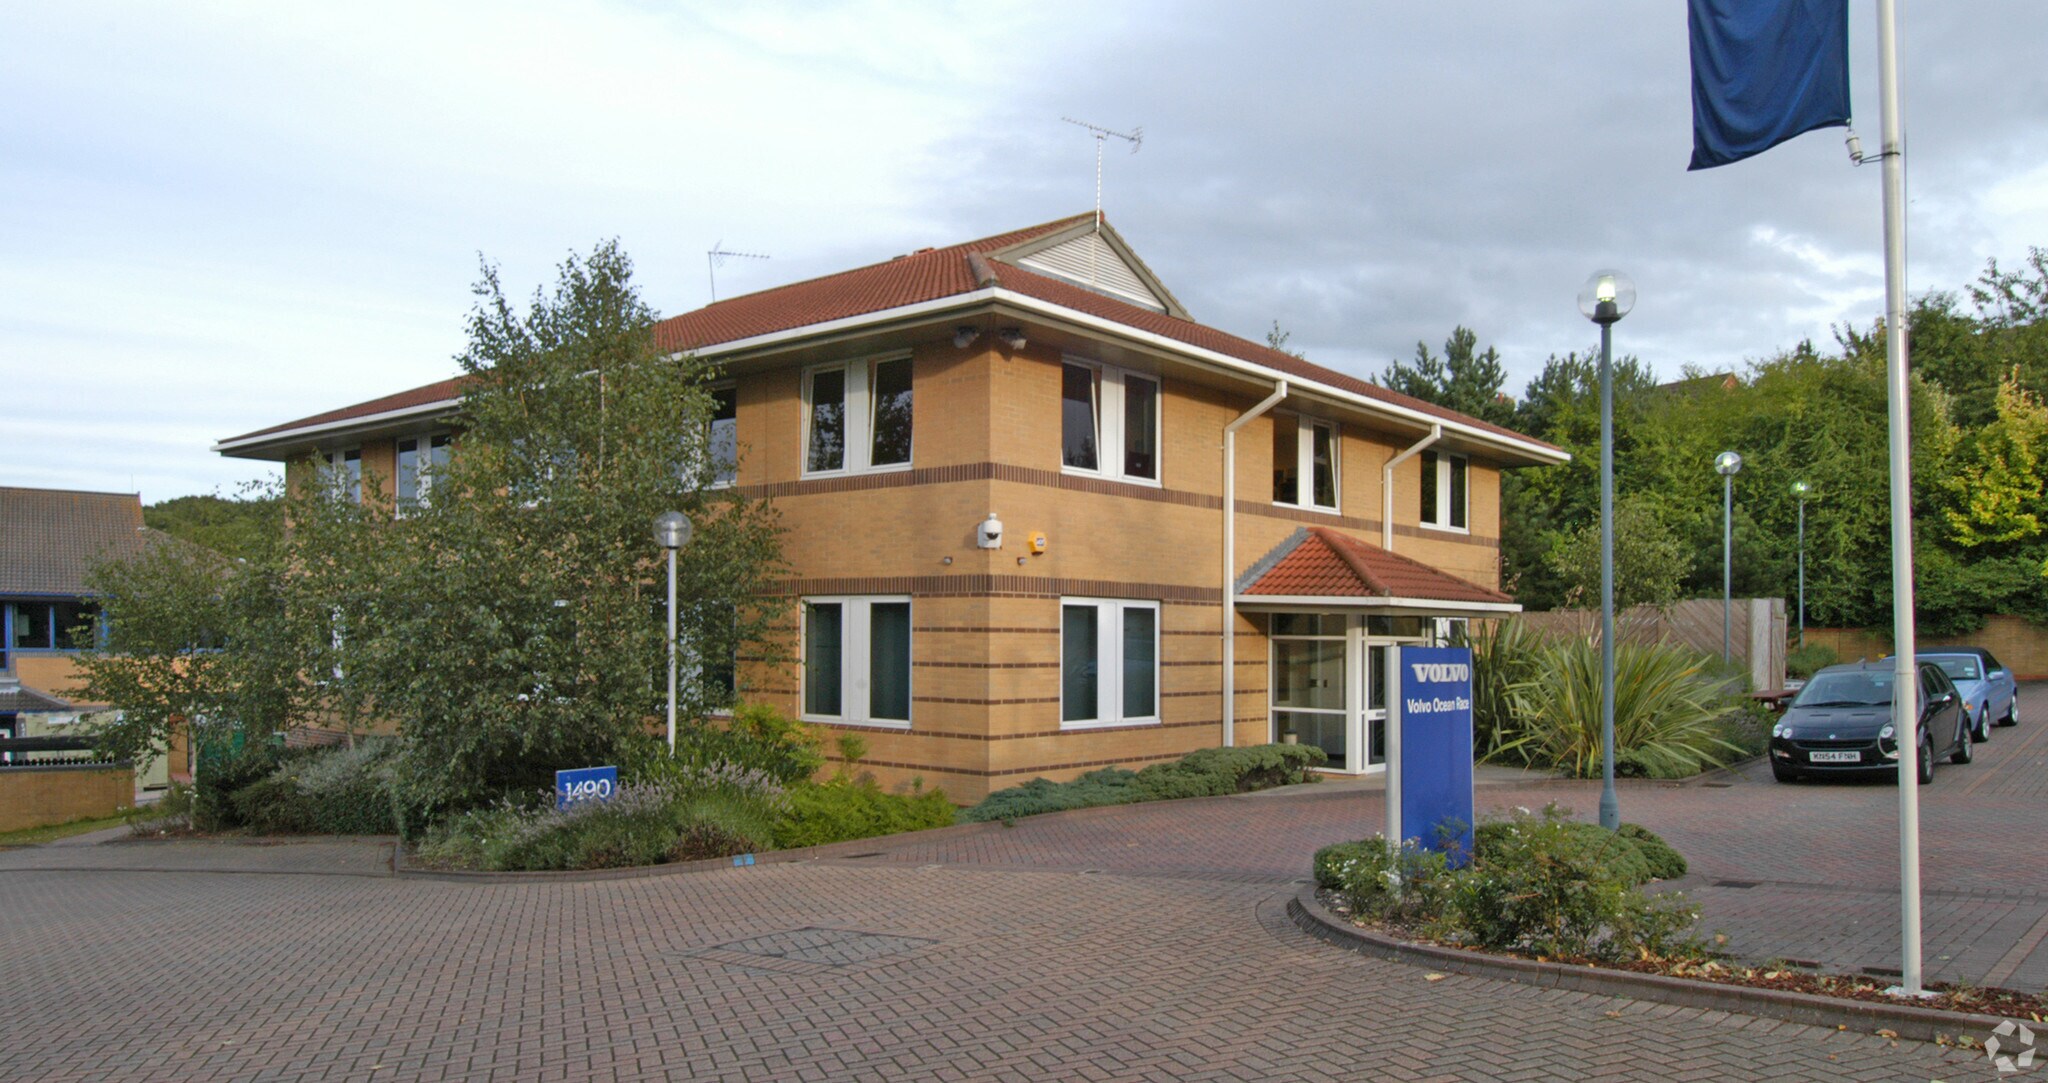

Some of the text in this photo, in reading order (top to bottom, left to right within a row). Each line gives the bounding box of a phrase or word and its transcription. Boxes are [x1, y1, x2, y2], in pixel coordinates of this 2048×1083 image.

[1411, 663, 1469, 683] VOLVO
[1407, 697, 1469, 714] Volvo Ocean Race
[565, 778, 611, 802] 1490
